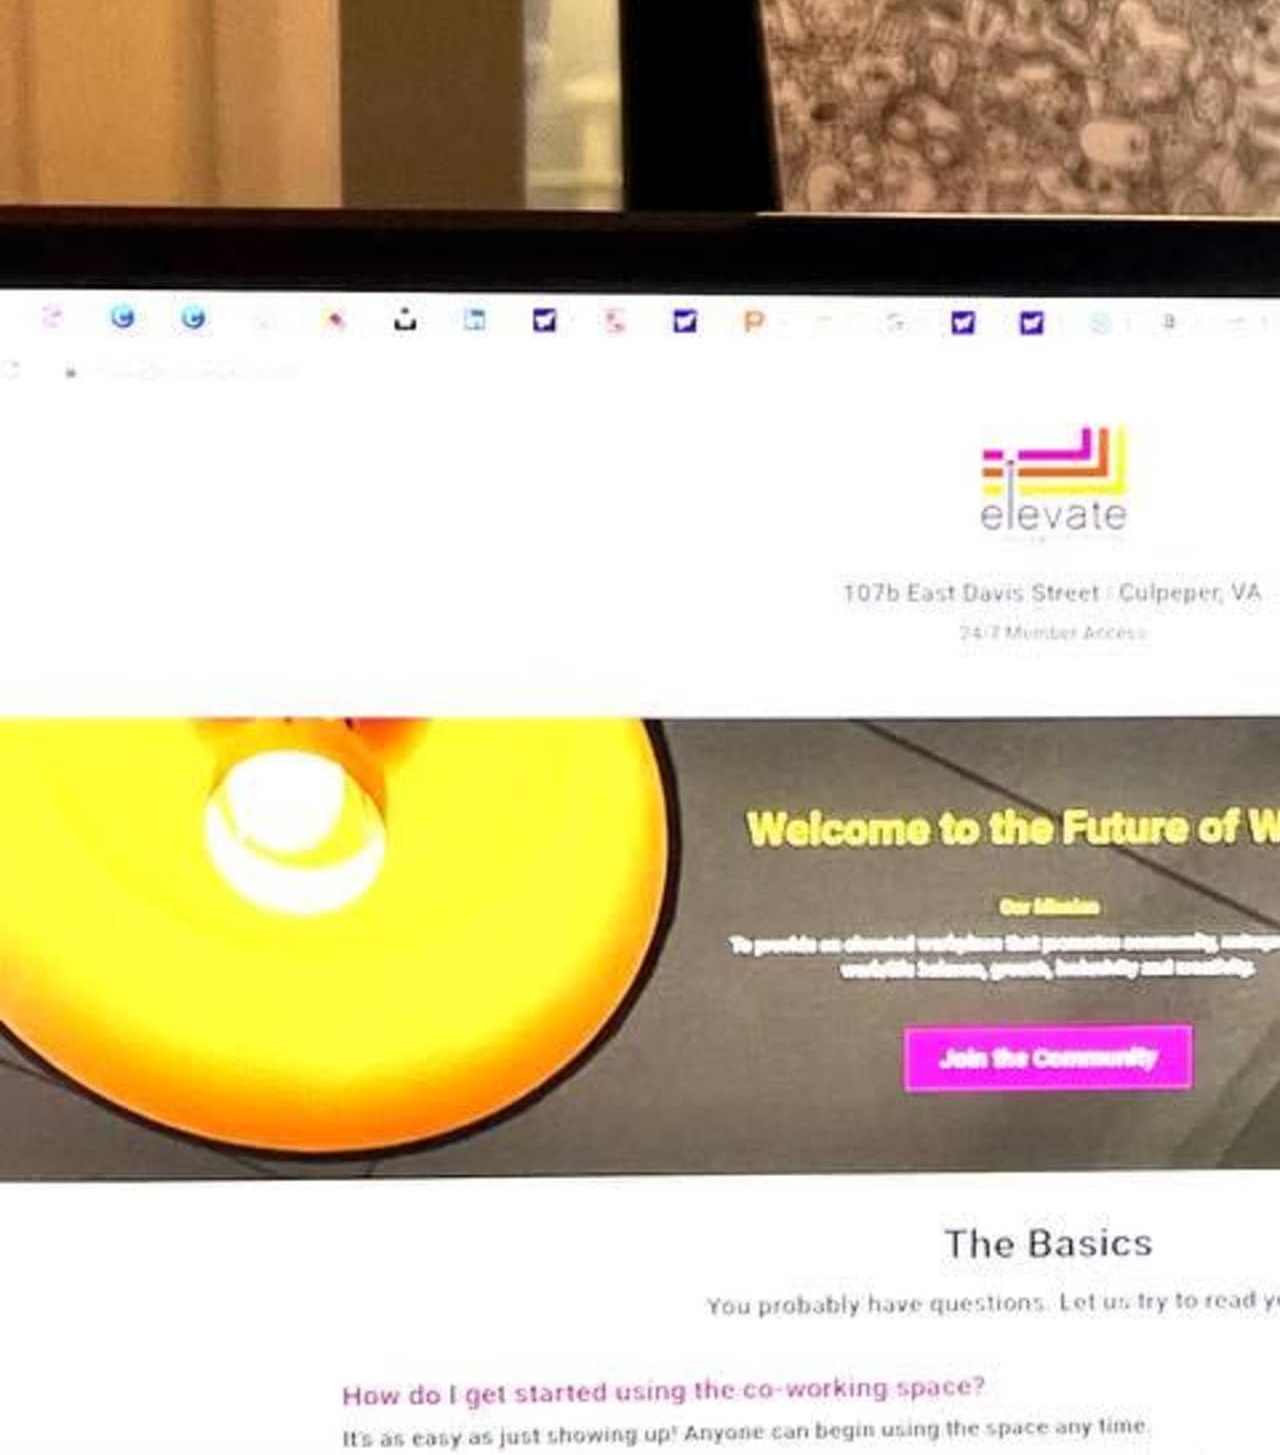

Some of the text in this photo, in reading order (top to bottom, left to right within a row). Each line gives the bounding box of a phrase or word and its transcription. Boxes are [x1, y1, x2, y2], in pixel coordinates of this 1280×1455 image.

[845, 582, 1262, 606] 107b East Davis Street Culpeper, VA
[1004, 624, 1077, 641] Member
[746, 809, 932, 847] Welcome
[939, 812, 981, 846] to
[988, 808, 1055, 845] the
[1063, 809, 1190, 846] Future
[1198, 807, 1241, 844] of
[939, 1046, 1159, 1072] Join the Community
[944, 1227, 1153, 1260] The Basics
[708, 1296, 751, 1316] You
[758, 1295, 860, 1320] probably
[868, 1294, 922, 1314] have
[1060, 1292, 1095, 1312] Let
[1103, 1296, 1130, 1311] us
[1138, 1293, 1168, 1315] try
[1175, 1292, 1199, 1310] to
[1205, 1291, 1257, 1310] read
[342, 1375, 985, 1411] How do I get started using the co-working space?
[343, 1429, 373, 1448] It's
[380, 1433, 405, 1448] as
[412, 1433, 463, 1451] easy
[468, 1431, 494, 1446] as
[499, 1428, 540, 1449] just
[547, 1426, 638, 1447] showing
[684, 1424, 764, 1445] Anyone
[771, 1425, 809, 1441] can
[815, 1422, 875, 1443] begin
[881, 1422, 940, 1442] using
[946, 1419, 980, 1438] the
[986, 1421, 1049, 1440] space
[1055, 1420, 1092, 1439] any
